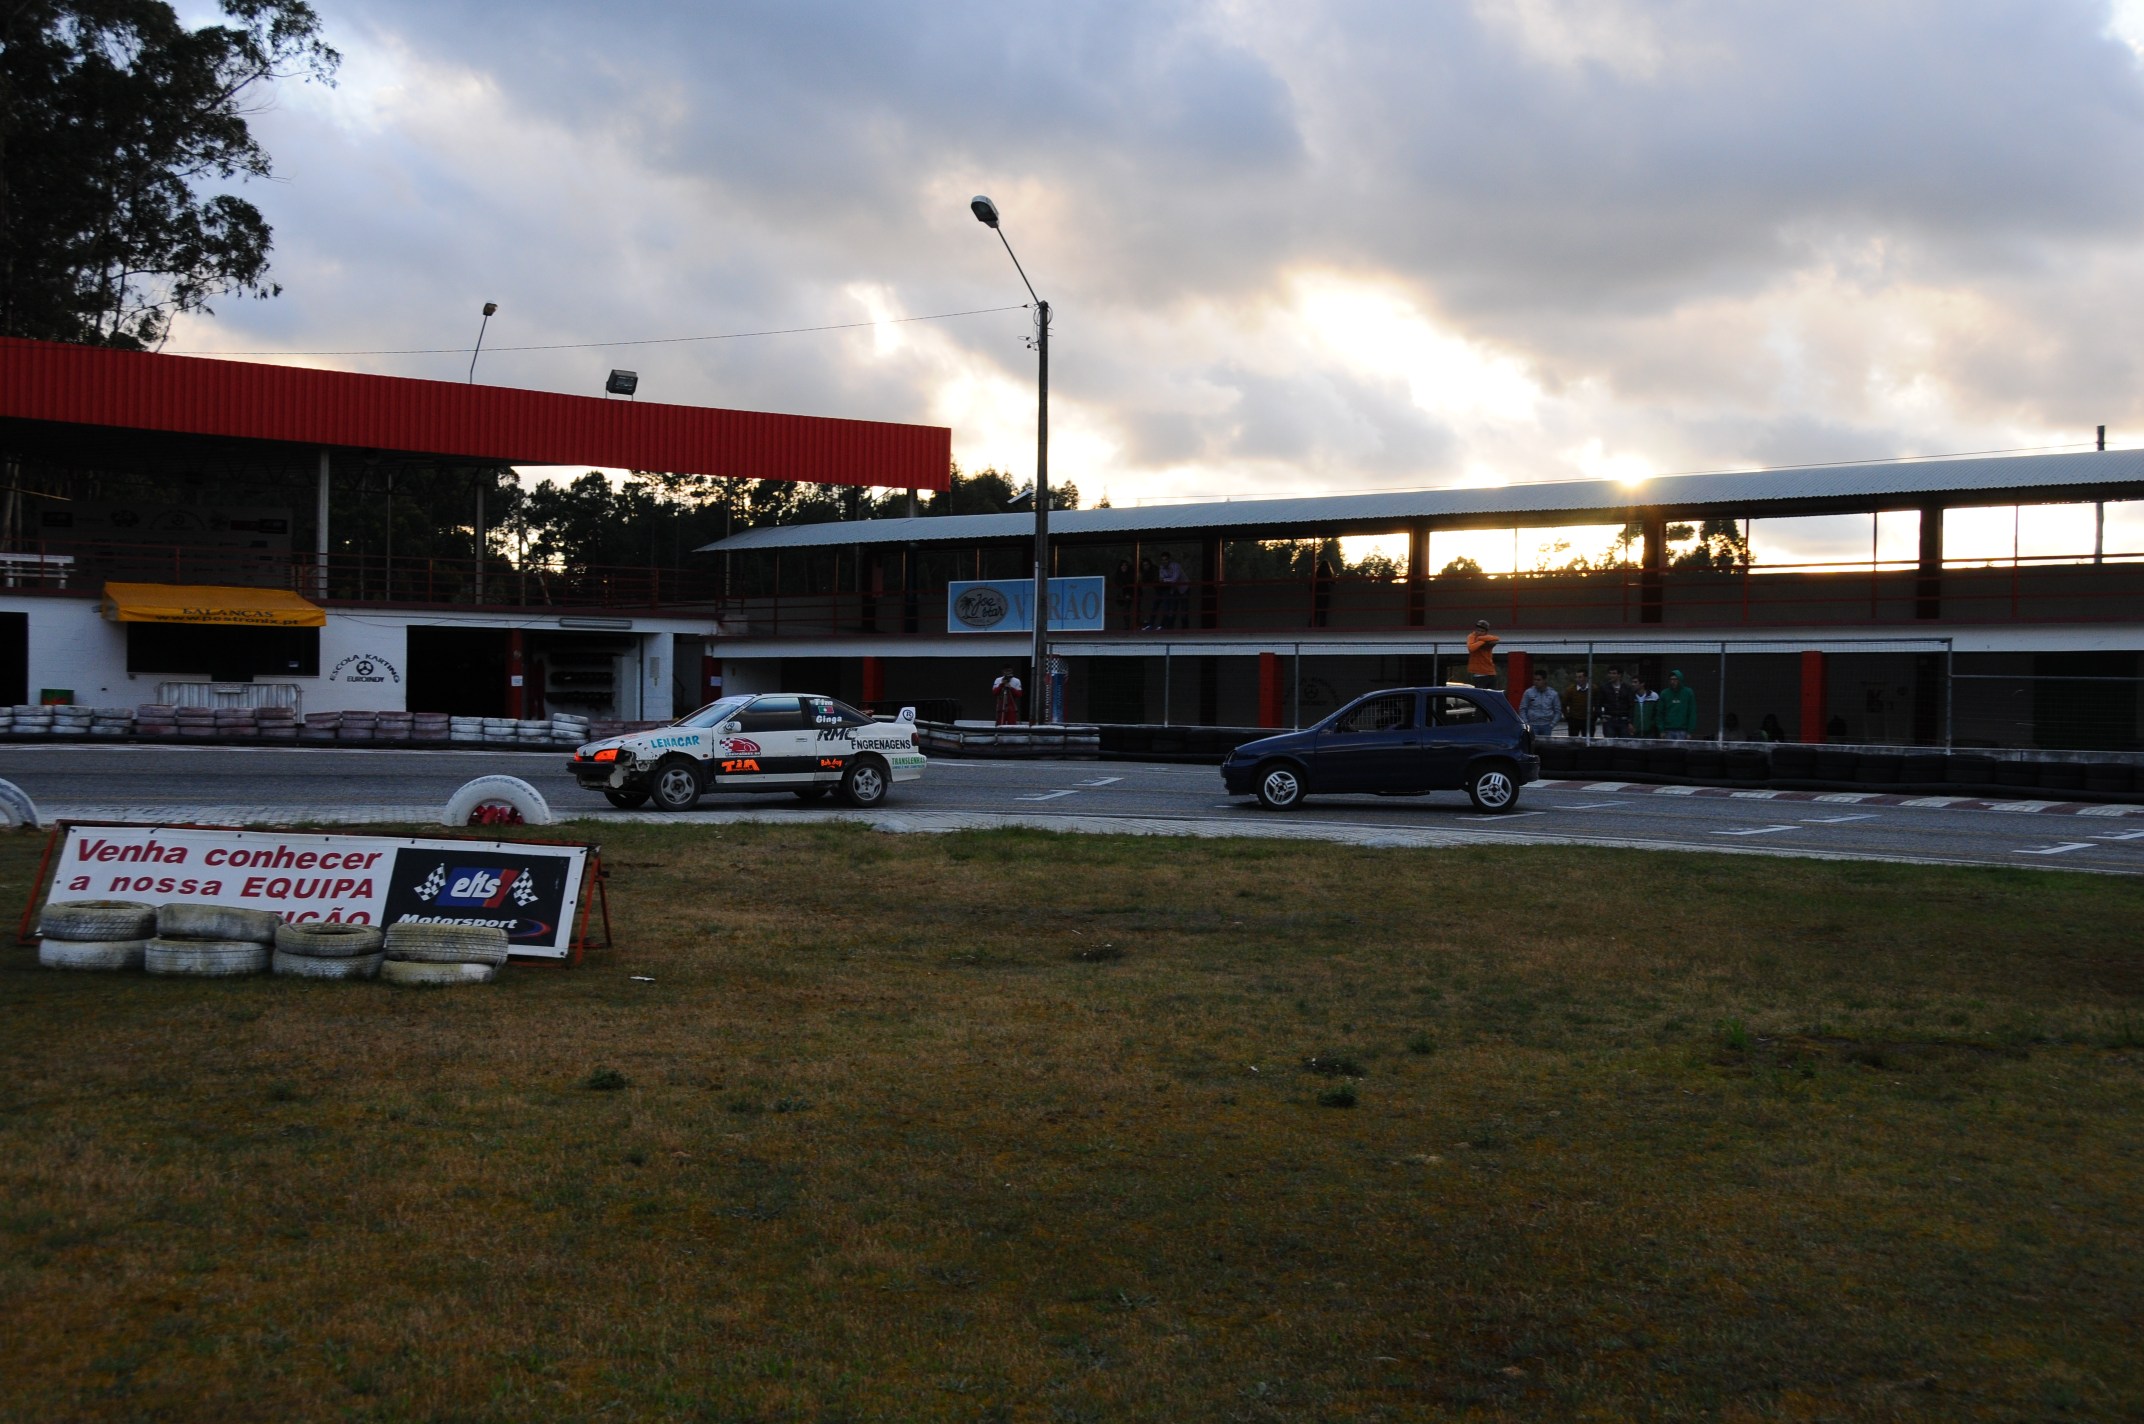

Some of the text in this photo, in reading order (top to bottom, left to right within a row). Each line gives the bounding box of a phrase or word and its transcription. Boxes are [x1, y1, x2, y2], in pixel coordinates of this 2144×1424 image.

[329, 653, 401, 684] ESCOLA KARTING
[346, 675, 385, 683] EUROINDY
[815, 715, 843, 725] Ginga
[651, 735, 700, 749] LENACAR
[77, 838, 384, 870] Venha conhecer
[68, 874, 374, 899] a nossa EQUIPA
